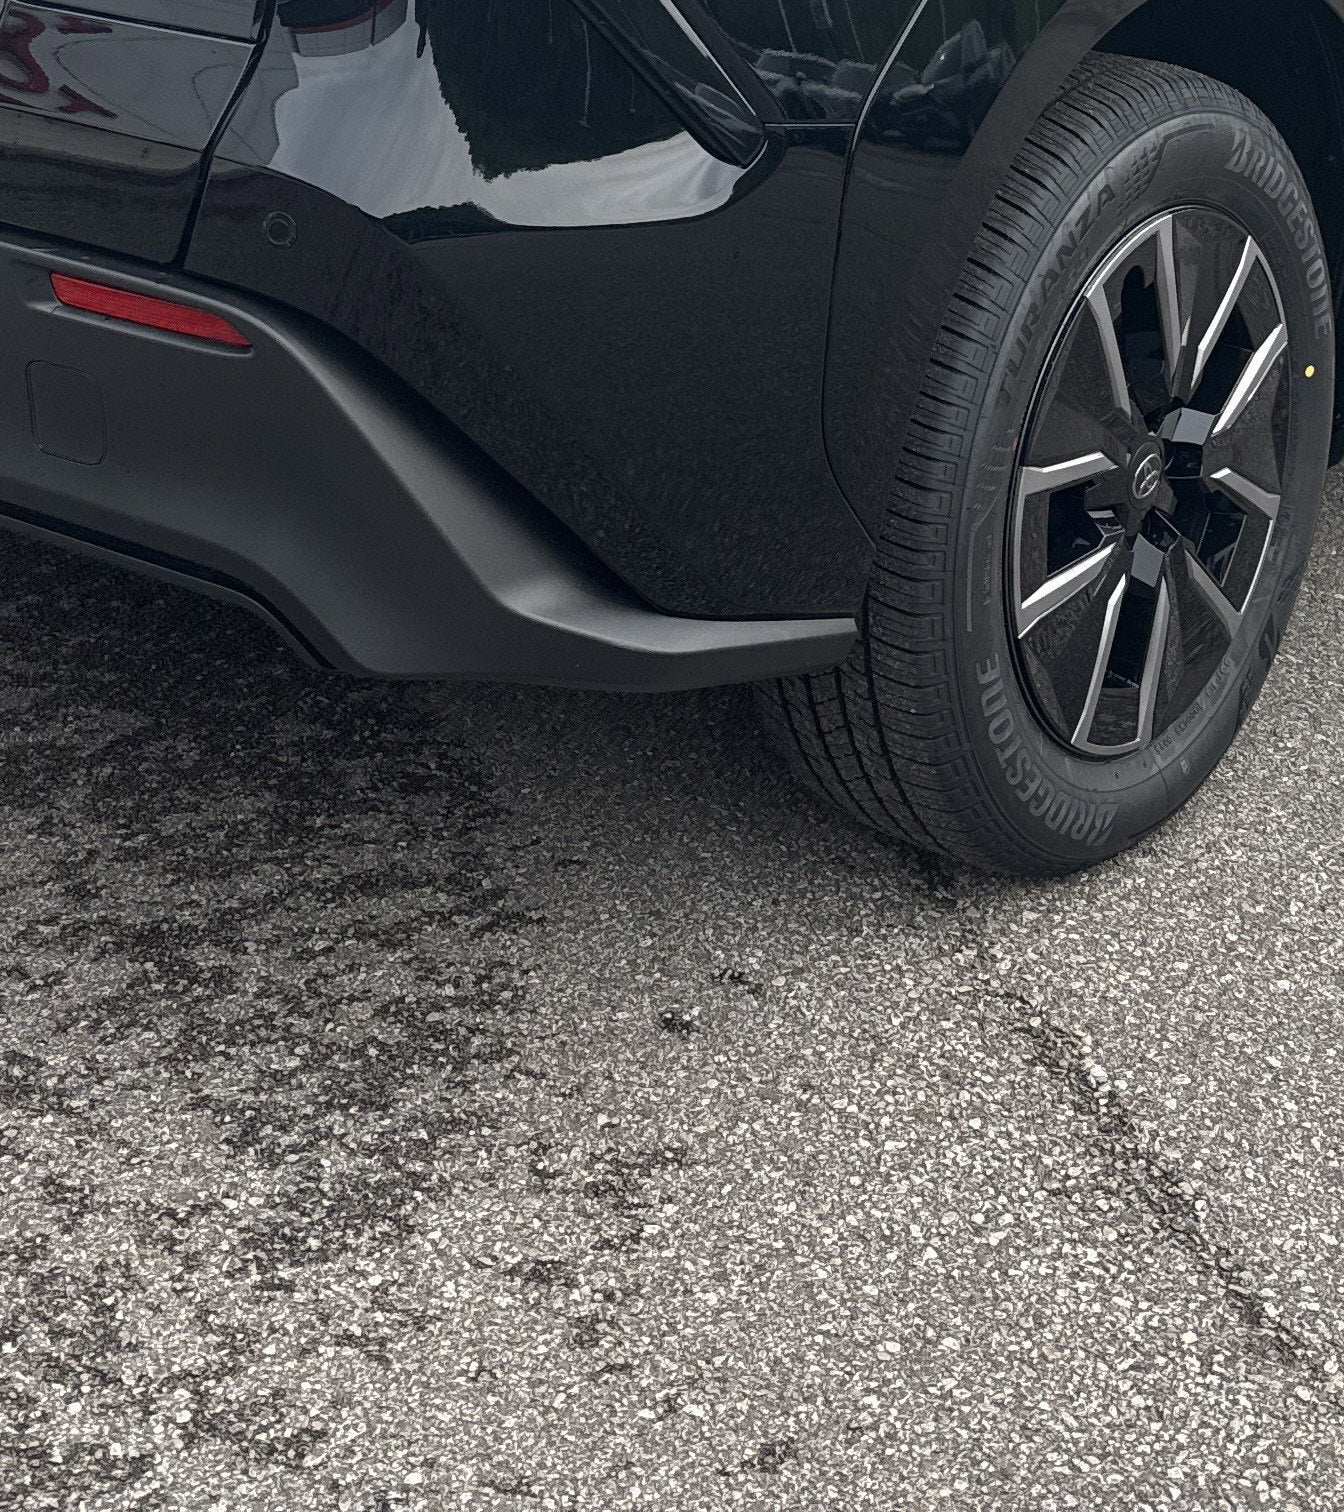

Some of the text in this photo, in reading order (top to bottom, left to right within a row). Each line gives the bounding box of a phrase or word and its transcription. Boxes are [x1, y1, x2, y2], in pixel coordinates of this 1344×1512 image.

[996, 184, 1116, 407] TURANZA
[1224, 129, 1333, 339] BRIDGESTONE
[976, 652, 1120, 847] BRIDGESTONE
